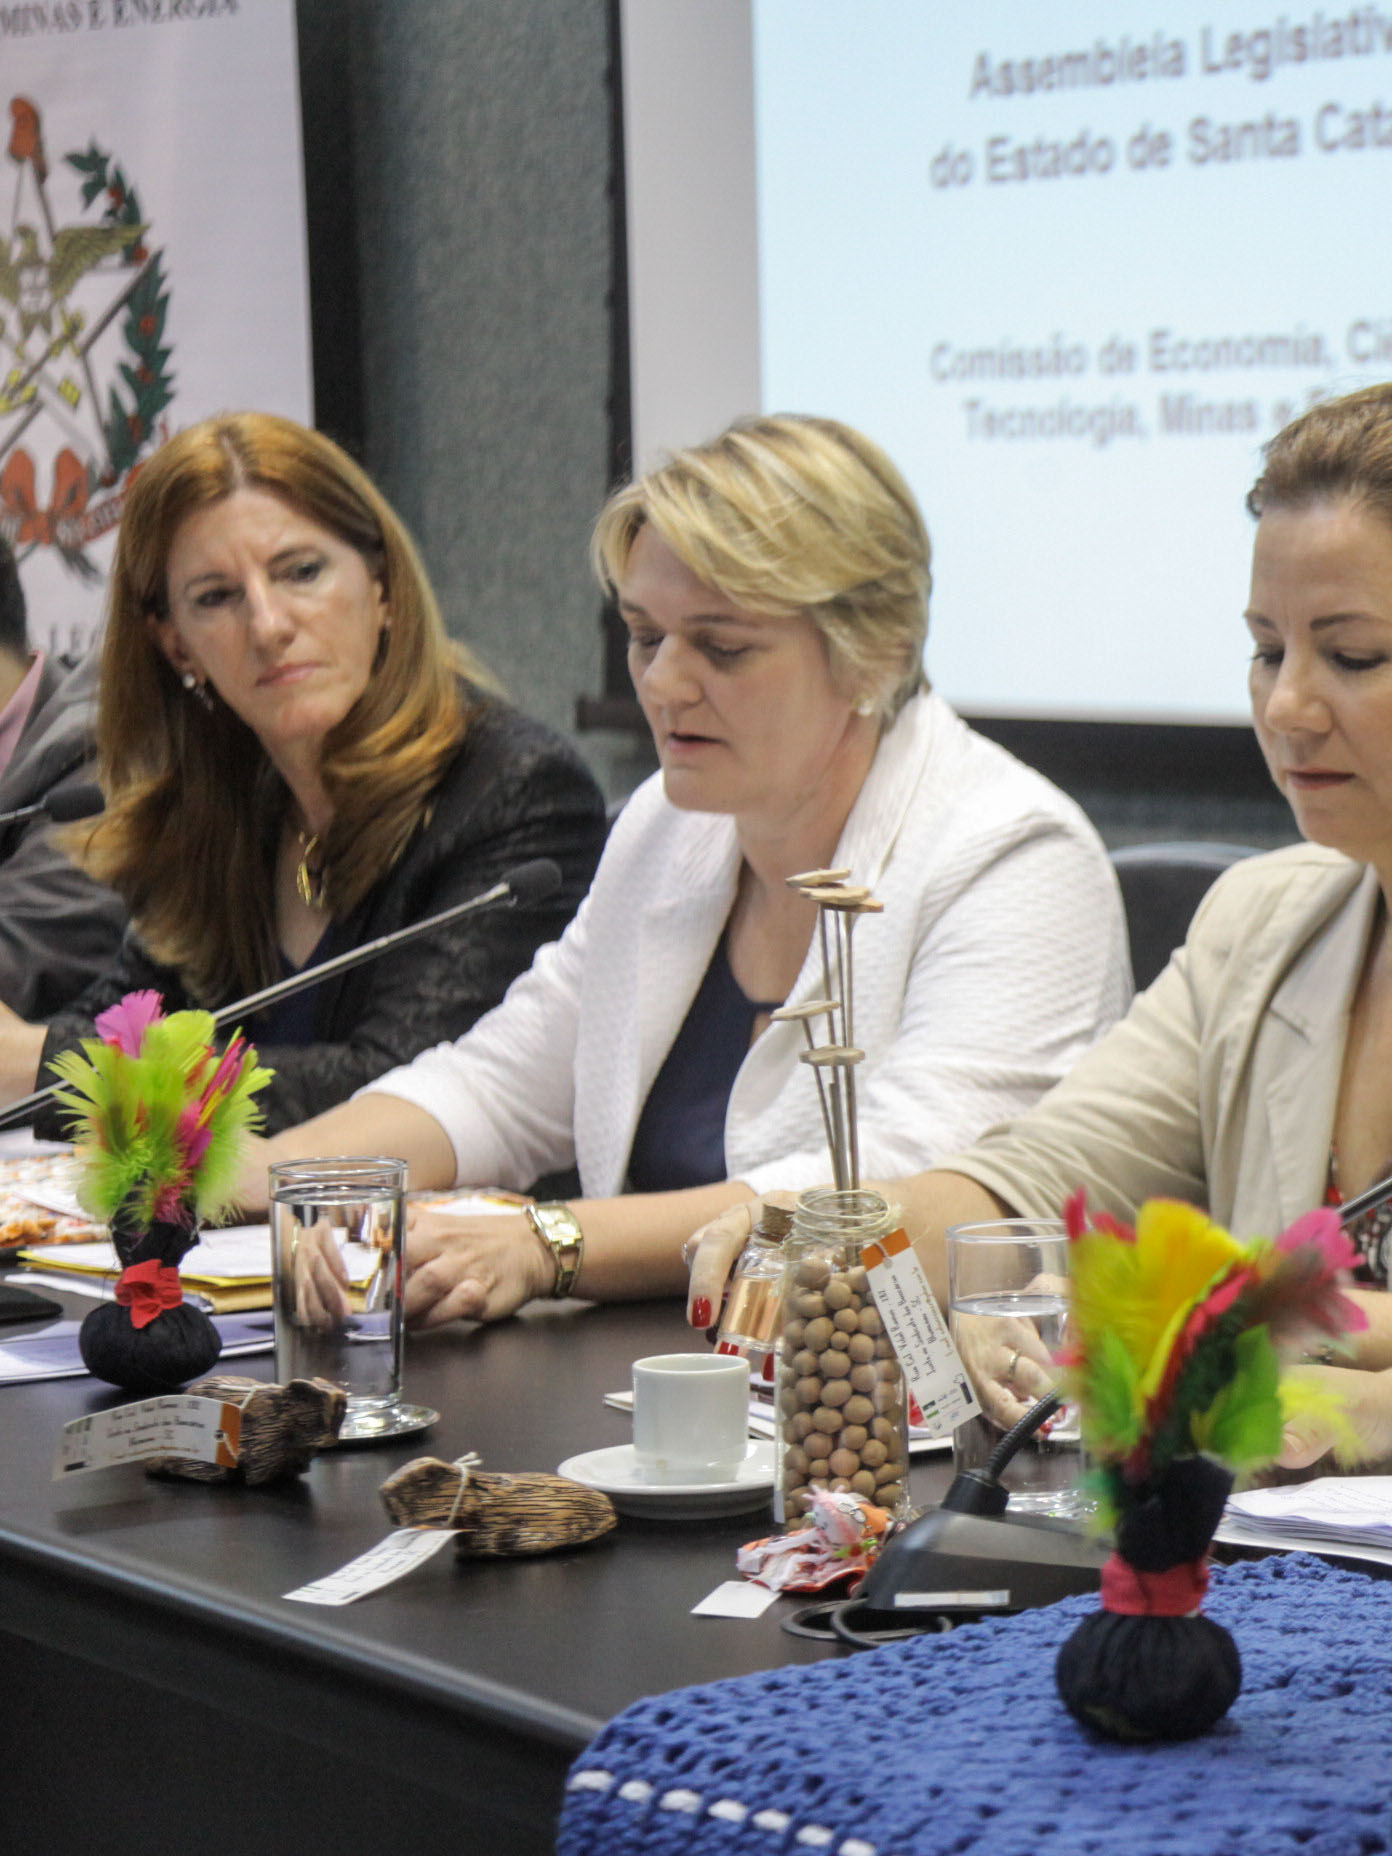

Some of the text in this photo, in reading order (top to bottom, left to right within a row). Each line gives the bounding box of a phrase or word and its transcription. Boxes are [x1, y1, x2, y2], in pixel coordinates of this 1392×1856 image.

[930, 140, 975, 188] do
[985, 126, 1116, 184] Estado
[1126, 119, 1174, 171] de
[1187, 112, 1302, 167] Santa
[1100, 331, 1138, 375] de
[1158, 390, 1257, 434] Minas
